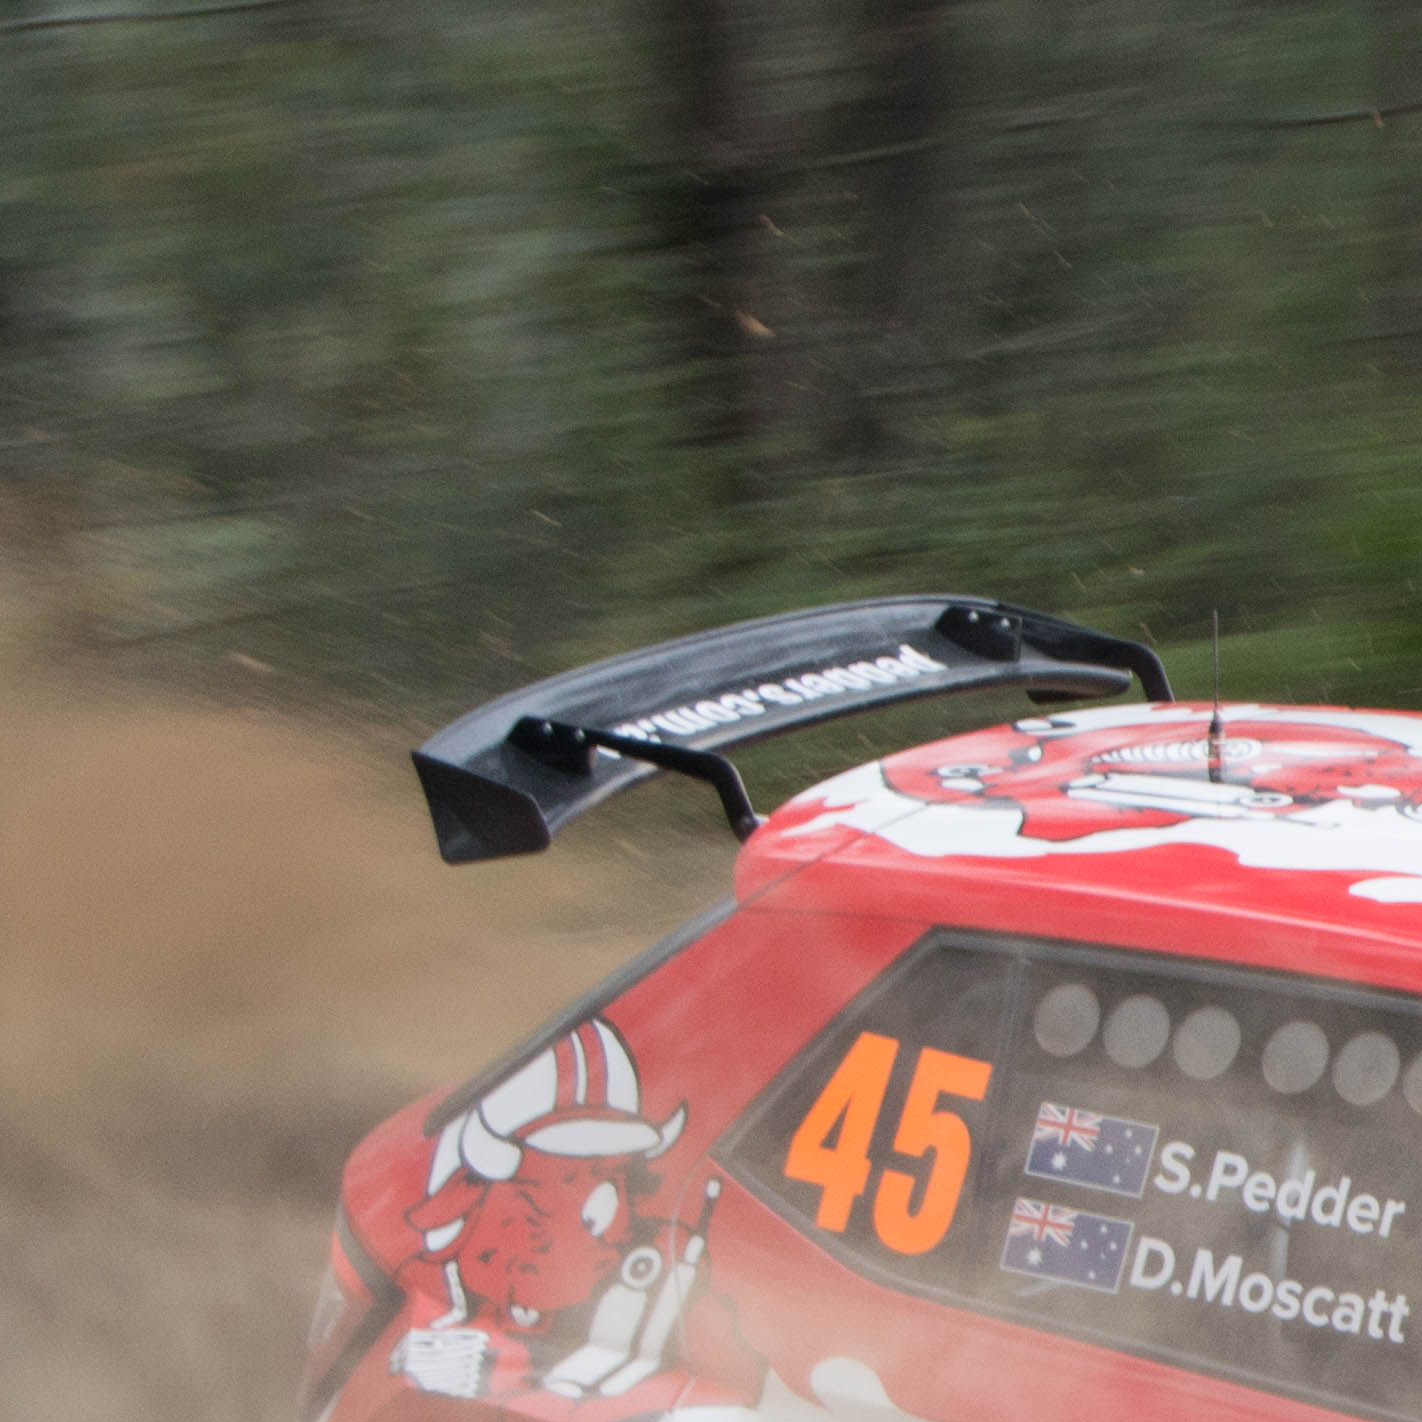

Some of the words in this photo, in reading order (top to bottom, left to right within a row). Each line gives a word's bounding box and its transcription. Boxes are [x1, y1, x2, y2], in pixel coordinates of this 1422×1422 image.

[784, 1030, 993, 1256] 45
[1154, 1141, 1406, 1238] S.Pedder
[1129, 1236, 1411, 1344] D.Moscatt
